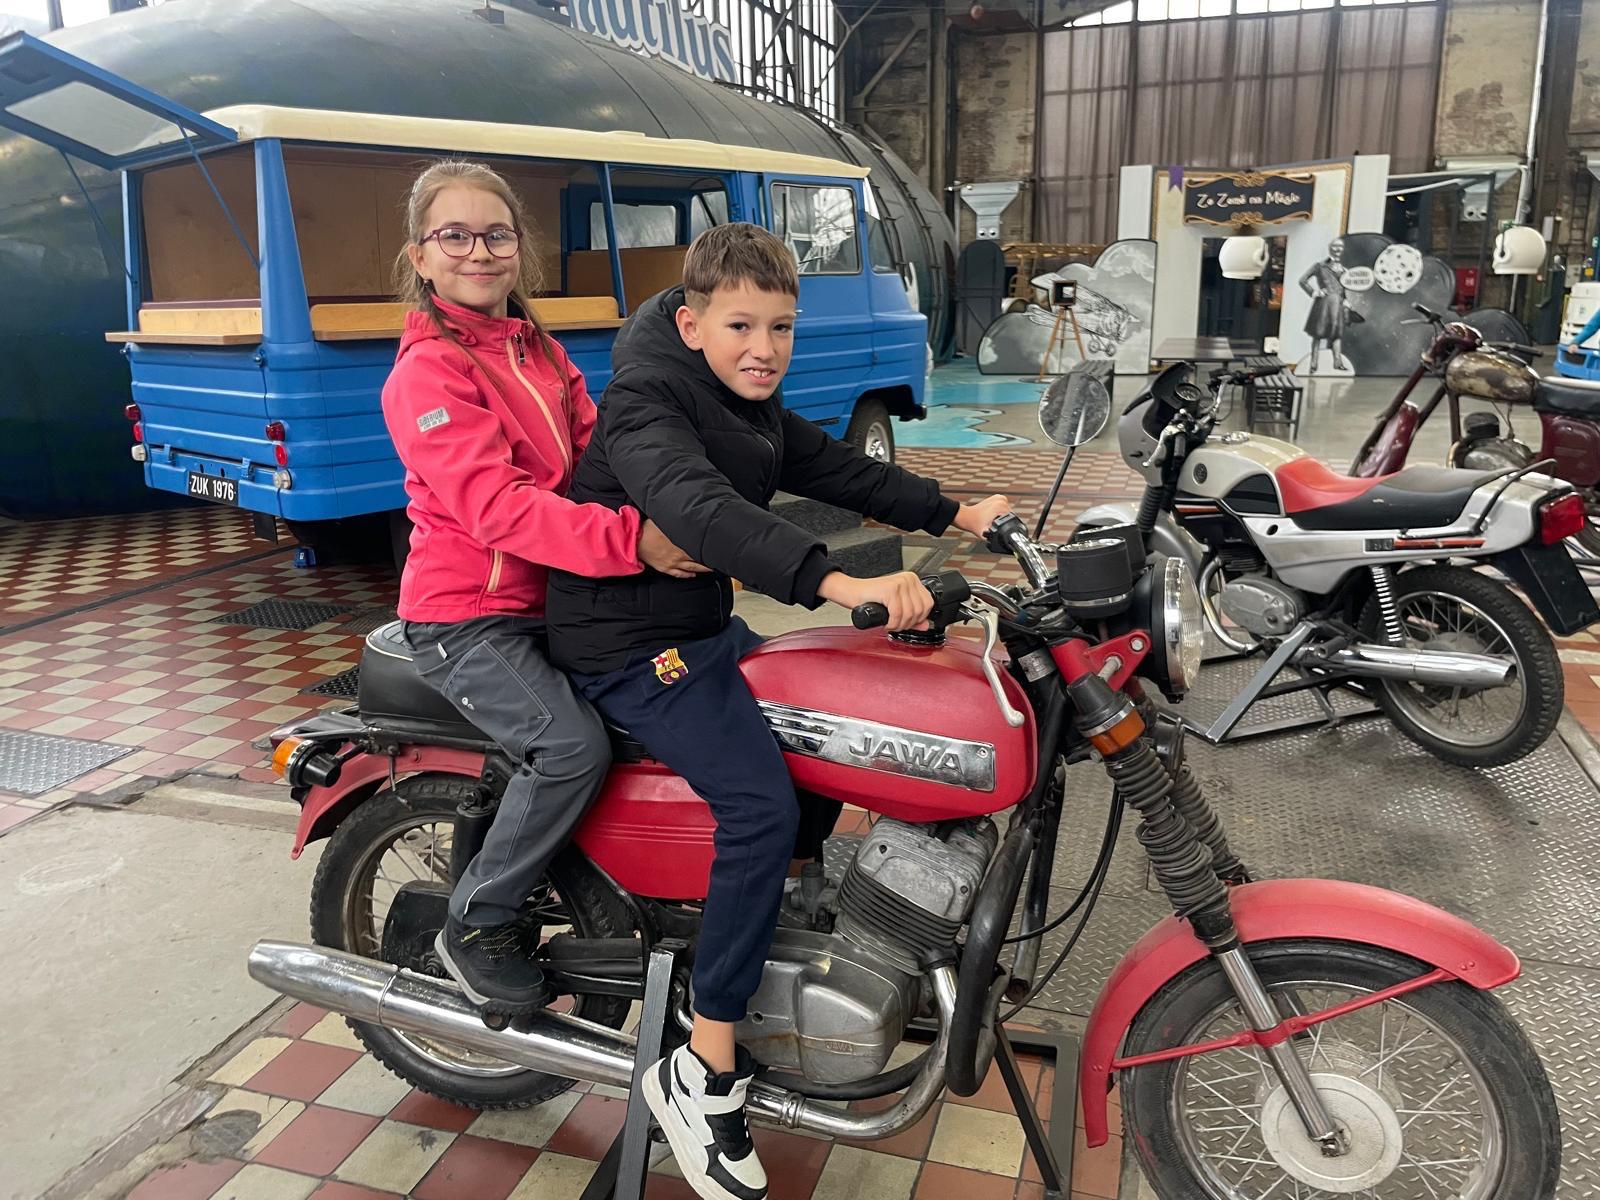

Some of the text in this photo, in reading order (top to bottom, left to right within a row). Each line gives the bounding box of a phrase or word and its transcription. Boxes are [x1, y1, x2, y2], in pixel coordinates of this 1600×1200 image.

[567, 0, 738, 84] autilus
[190, 475, 234, 501] ZUK 1976
[848, 732, 966, 774] JAWA
